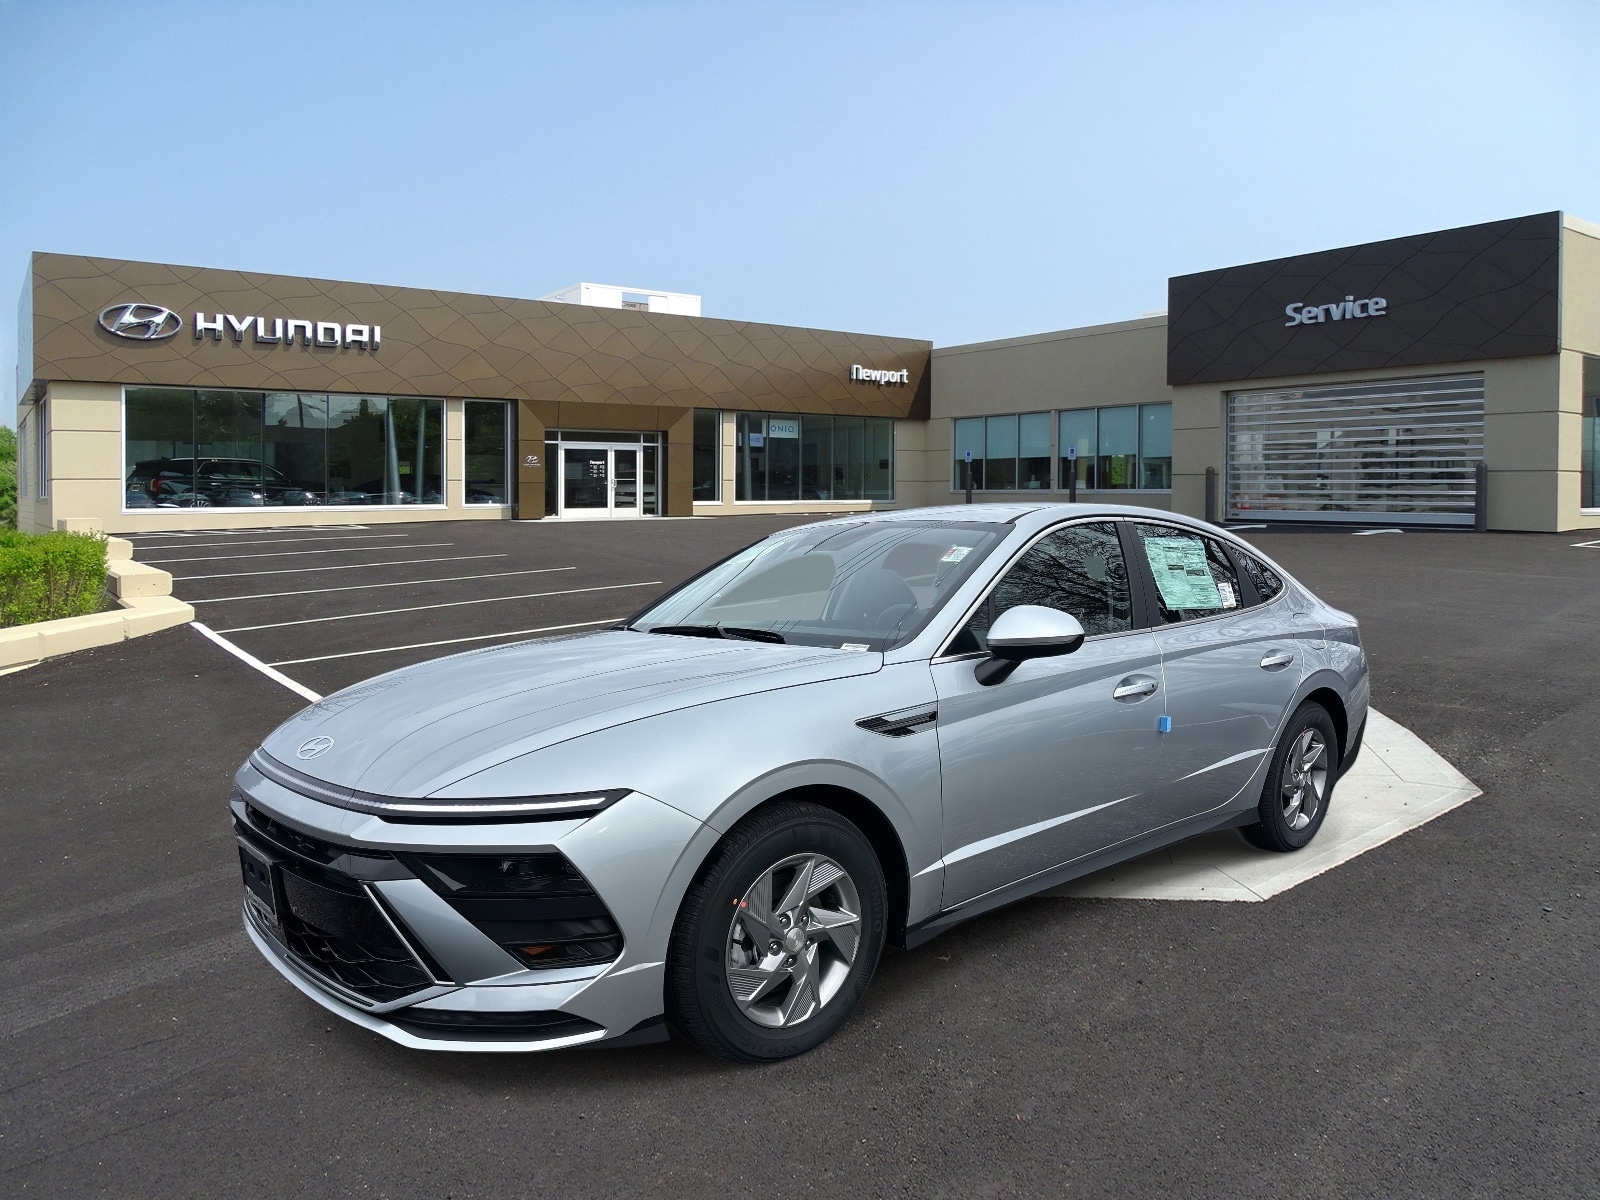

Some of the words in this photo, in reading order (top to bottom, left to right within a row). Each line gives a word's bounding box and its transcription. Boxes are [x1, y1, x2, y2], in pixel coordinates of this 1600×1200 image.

[1285, 295, 1387, 327] Service
[195, 312, 381, 350] HYUNDAI
[850, 364, 909, 385] Newport
[770, 424, 795, 433] ONIQ
